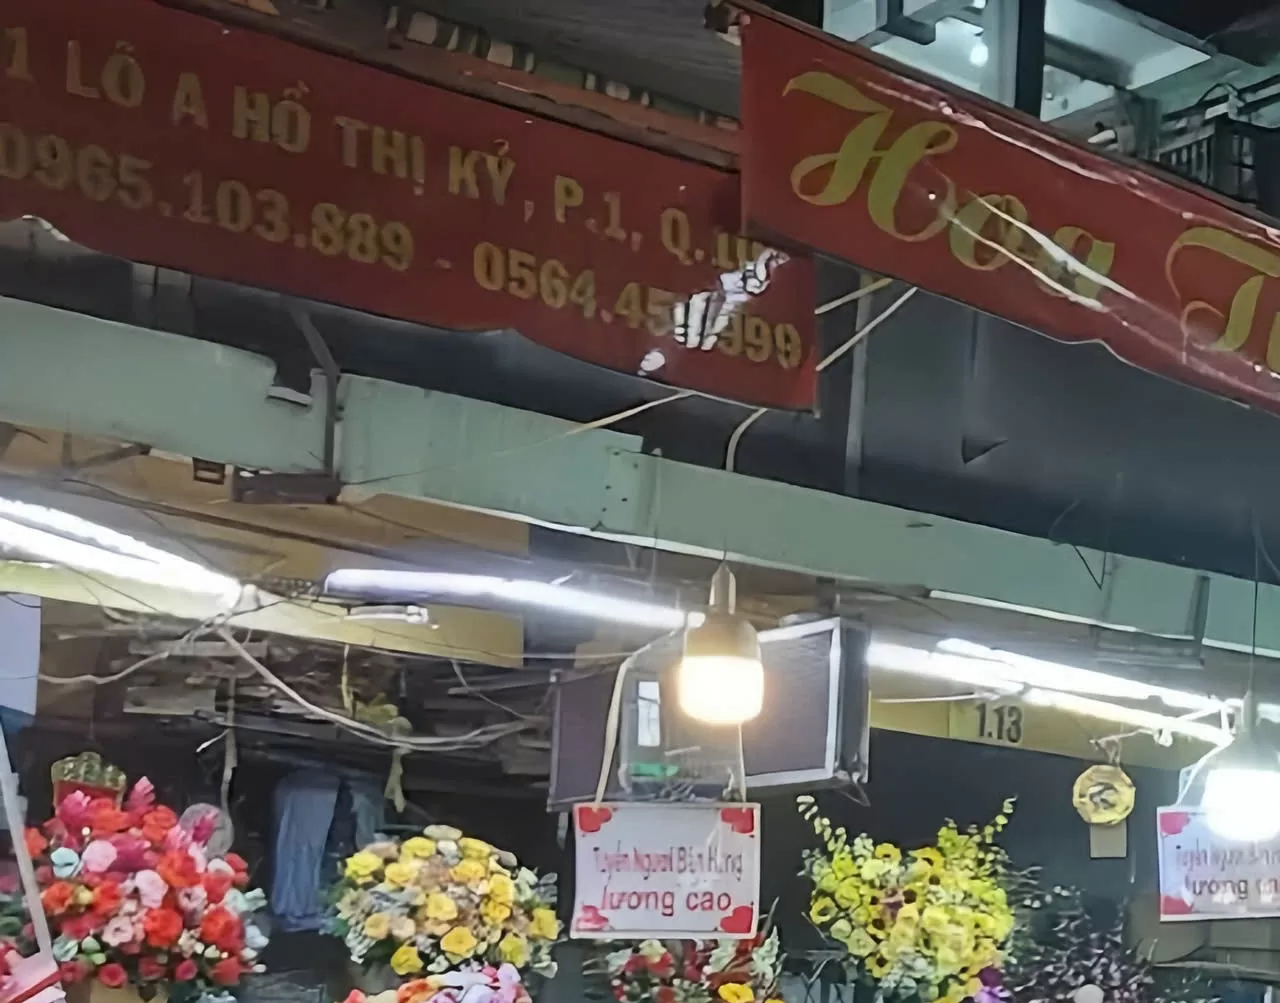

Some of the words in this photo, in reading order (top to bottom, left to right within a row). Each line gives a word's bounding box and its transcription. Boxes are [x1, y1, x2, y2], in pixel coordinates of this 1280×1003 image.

[0, 121, 414, 272] 0965.103.889
[172, 71, 209, 129] A
[334, 115, 426, 197] THỊ
[782, 71, 1117, 300] Hoa
[976, 702, 1024, 744] 1.13
[685, 890, 732, 911] cao
